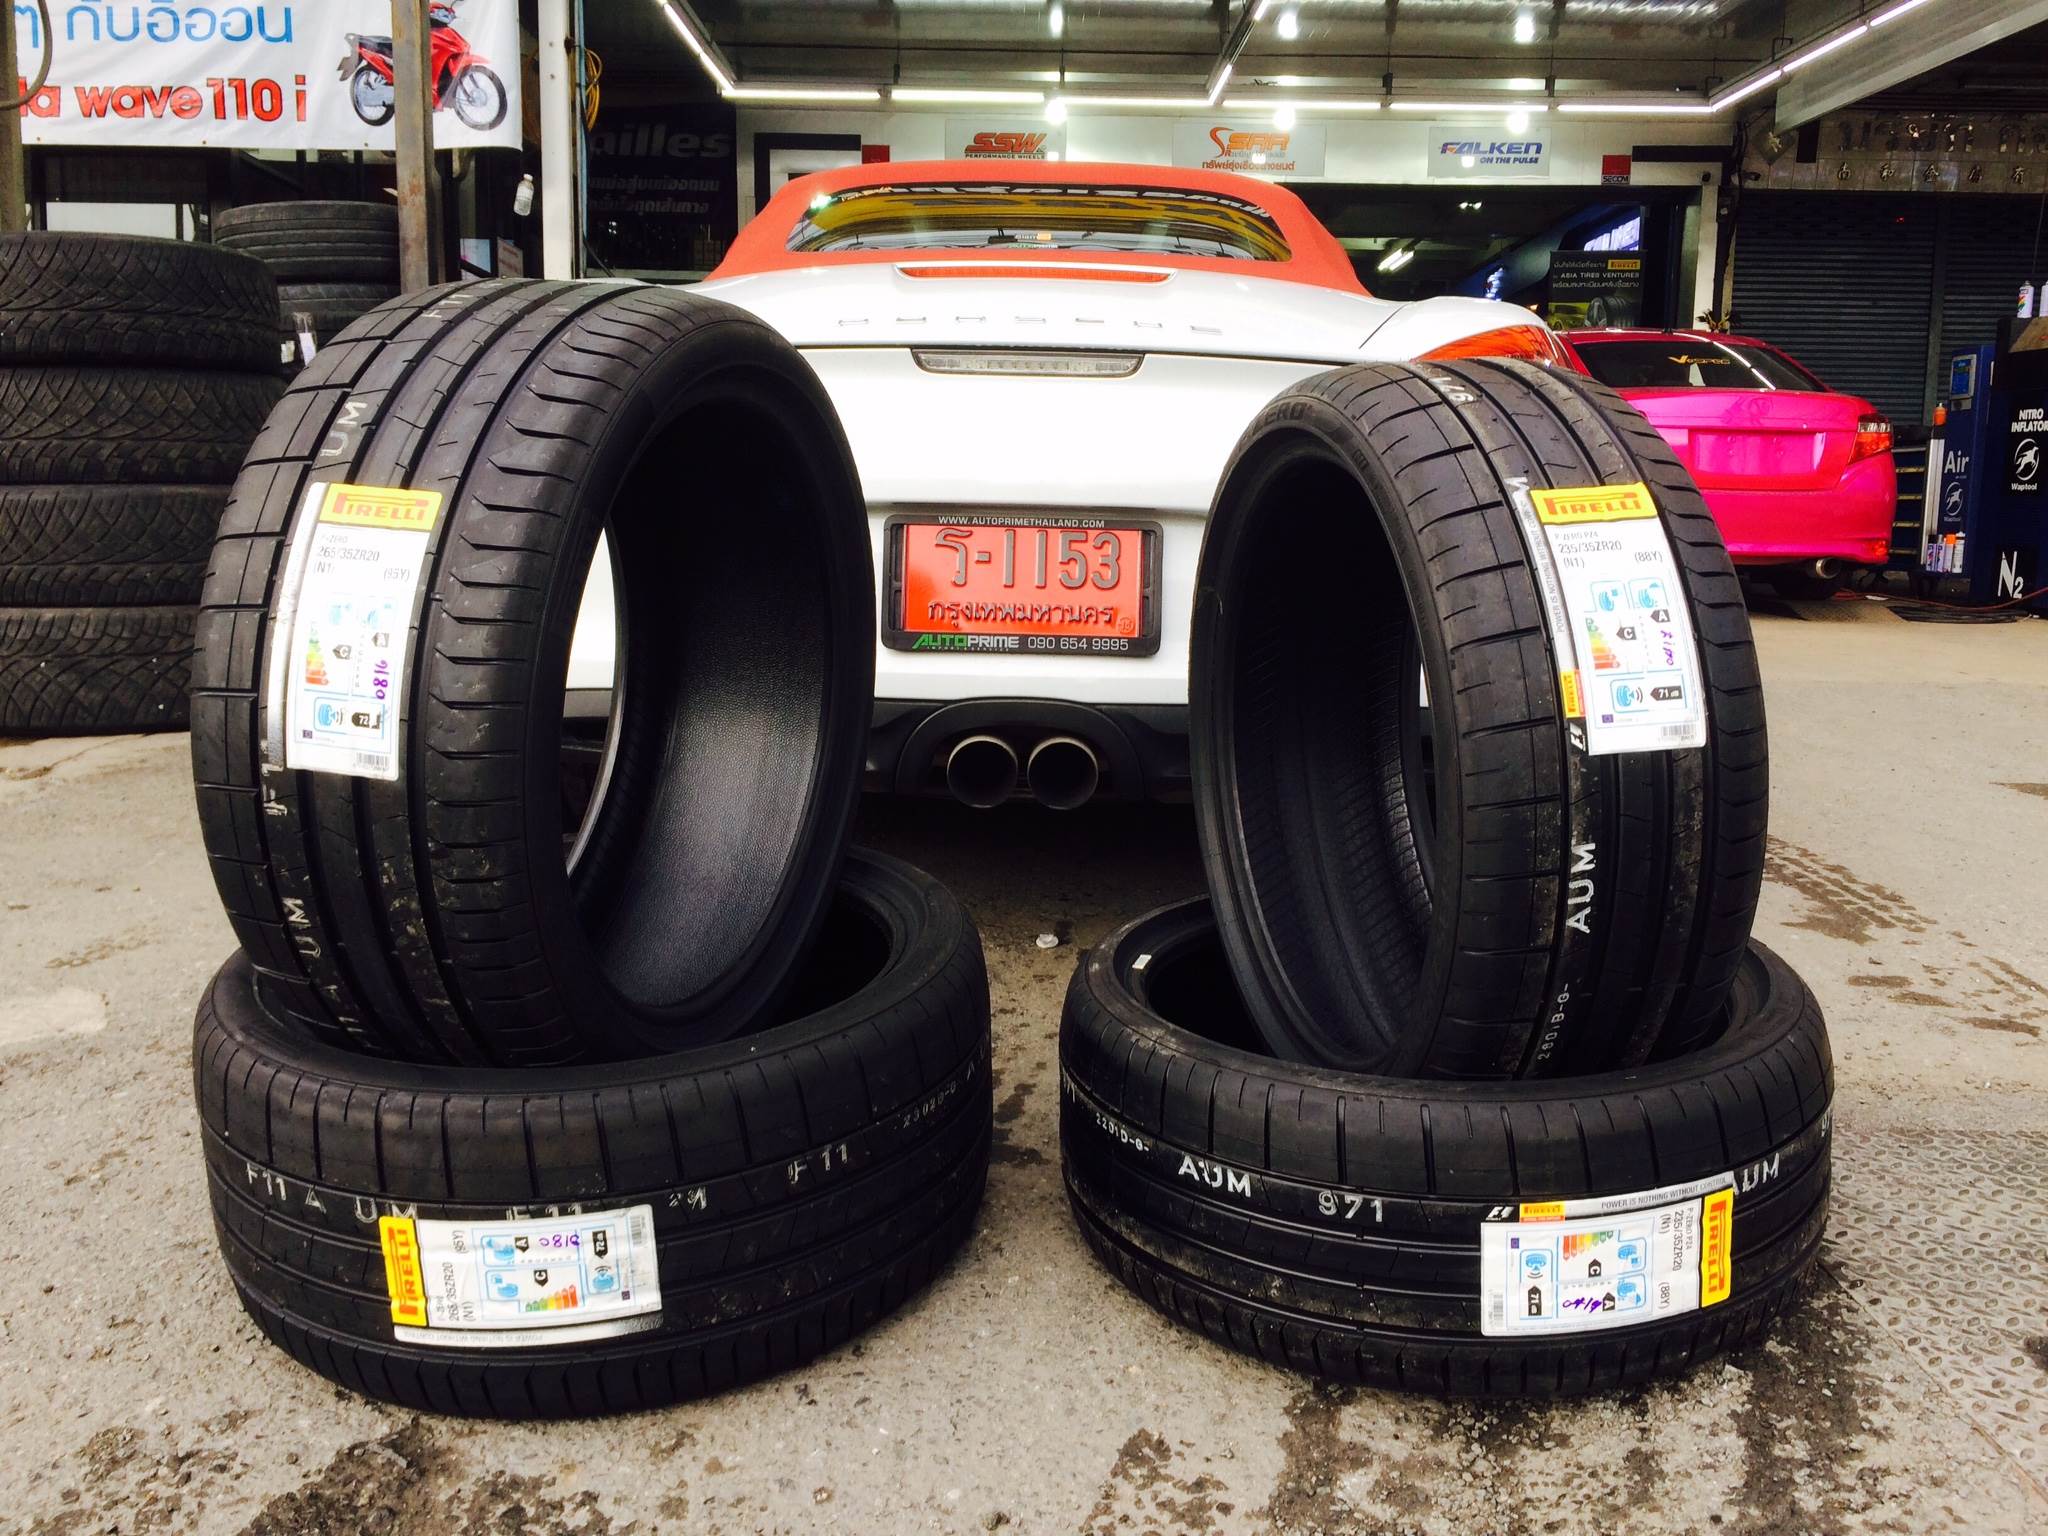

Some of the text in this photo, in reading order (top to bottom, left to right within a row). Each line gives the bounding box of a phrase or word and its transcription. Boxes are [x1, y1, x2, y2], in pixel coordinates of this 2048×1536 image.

[74, 85, 203, 120] wave
[206, 77, 283, 122] 110
[964, 132, 1047, 153] SSW
[1440, 142, 1543, 155] FALKEN
[1480, 156, 1495, 164] ON
[1495, 156, 1511, 164] THE
[1602, 175, 1630, 183] SECOM
[2018, 408, 2044, 421] NITRO
[1944, 450, 1970, 474] Air
[2011, 482, 2038, 492] Waptool
[332, 492, 429, 521] PIRELLI
[1543, 491, 1642, 516] PIRELLI
[1558, 541, 1622, 555] 235/35ZR20
[1634, 551, 1663, 564] (88Y)
[928, 600, 1114, 627] กรุงเทพมหานคร
[912, 634, 1020, 649] AUTOPRIME
[1028, 636, 1055, 649] 090
[1060, 637, 1088, 649] 654
[1092, 637, 1129, 650] 9995
[1658, 689, 1670, 699] 71
[1565, 842, 1597, 934] AUM
[246, 1162, 286, 1200] F11
[1178, 1150, 1252, 1198] AUM
[1601, 1199, 1628, 1209] POWER
[1629, 1197, 1637, 1206] IS
[1638, 1192, 1669, 1204] NOTHING
[1669, 1185, 1699, 1199] WITHOUT
[1673, 1210, 1685, 1272] 235/35ZR20
[1707, 1200, 1728, 1294] PIRELLI
[387, 1227, 418, 1316] PIRELLI
[1657, 1281, 1670, 1310] (88Y)
